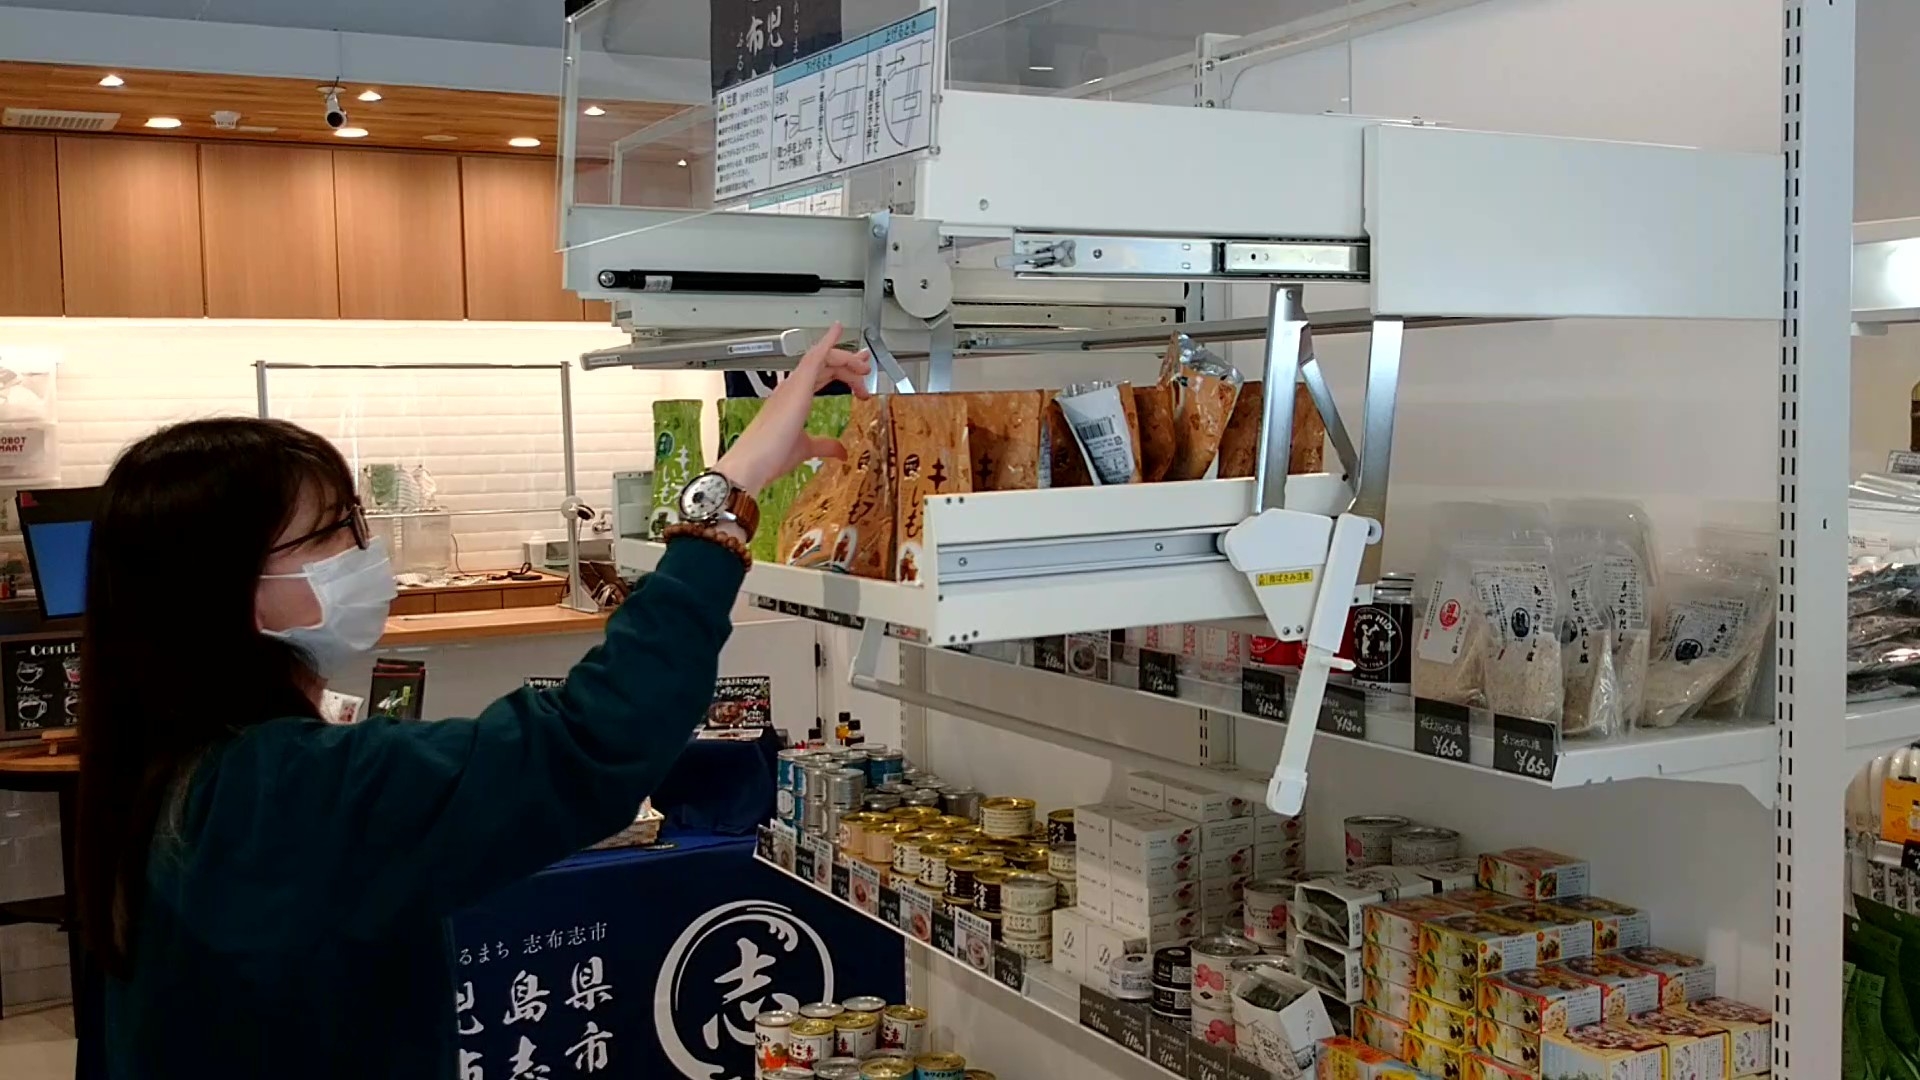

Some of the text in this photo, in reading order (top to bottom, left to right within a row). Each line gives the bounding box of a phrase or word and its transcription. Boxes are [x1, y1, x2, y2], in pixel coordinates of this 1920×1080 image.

[885, 19, 917, 43] 上げるとき
[804, 53, 833, 73] 下げるとき
[1269, 572, 1310, 583] 指ばさみ注意
[1432, 735, 1463, 757] ¥650
[1514, 750, 1551, 776] ¥650
[459, 922, 608, 965] るまち 志布志市
[702, 937, 800, 1050] 志
